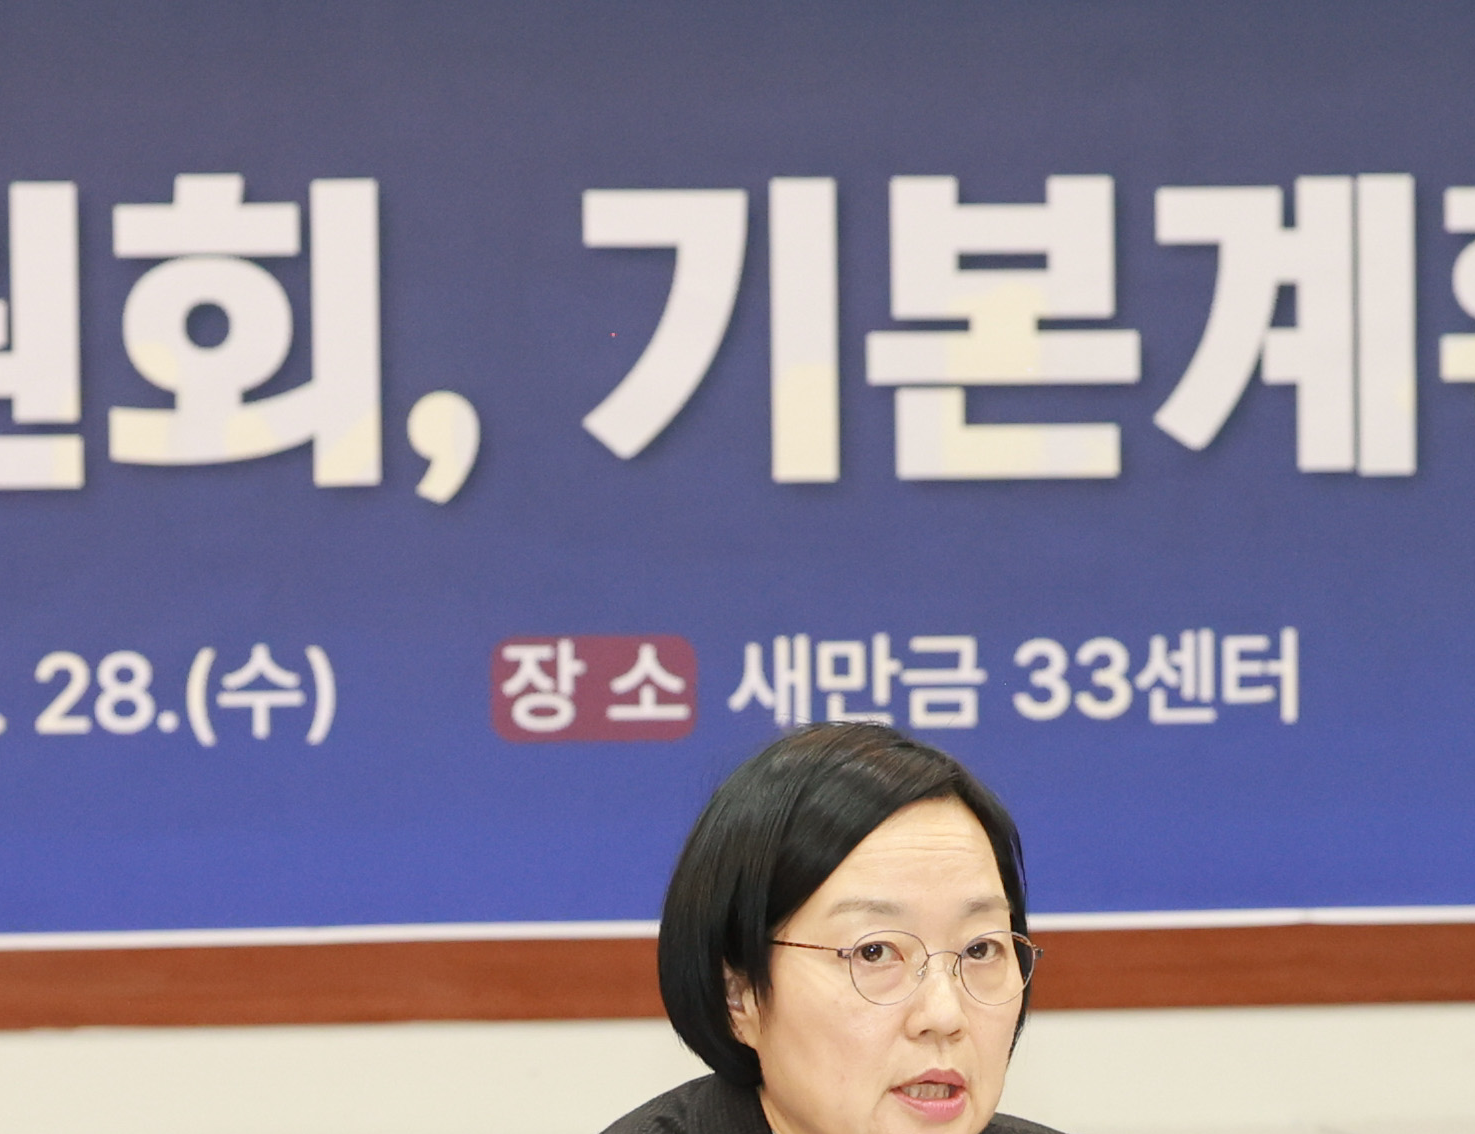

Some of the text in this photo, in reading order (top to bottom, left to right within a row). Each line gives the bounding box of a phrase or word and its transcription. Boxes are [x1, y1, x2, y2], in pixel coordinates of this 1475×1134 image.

[34, 643, 336, 747] 28.(수)
[728, 632, 987, 730] 새만금
[1013, 626, 1300, 725] 33센터
